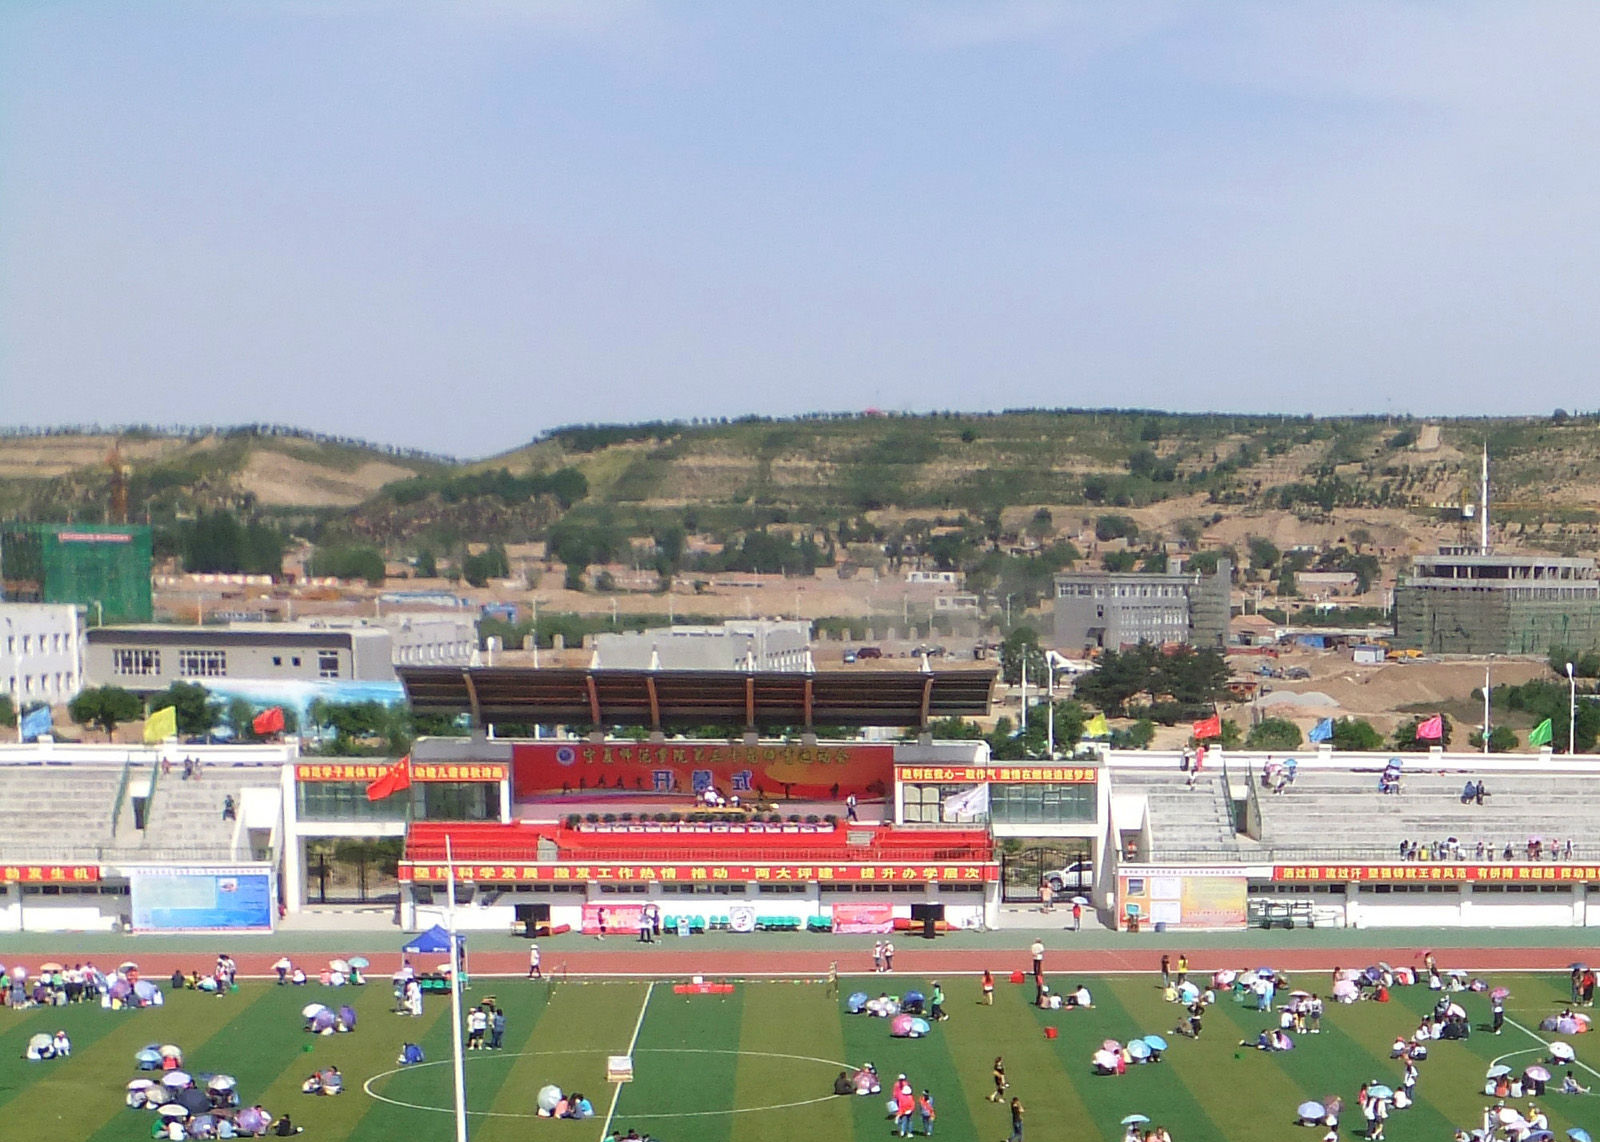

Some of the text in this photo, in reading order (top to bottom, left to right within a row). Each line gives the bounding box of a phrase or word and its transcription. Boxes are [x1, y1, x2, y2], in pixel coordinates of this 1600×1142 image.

[413, 866, 539, 881] 坚持科学发展
[554, 866, 677, 881] 激发工作热情
[860, 866, 980, 881] 提升办学层次
